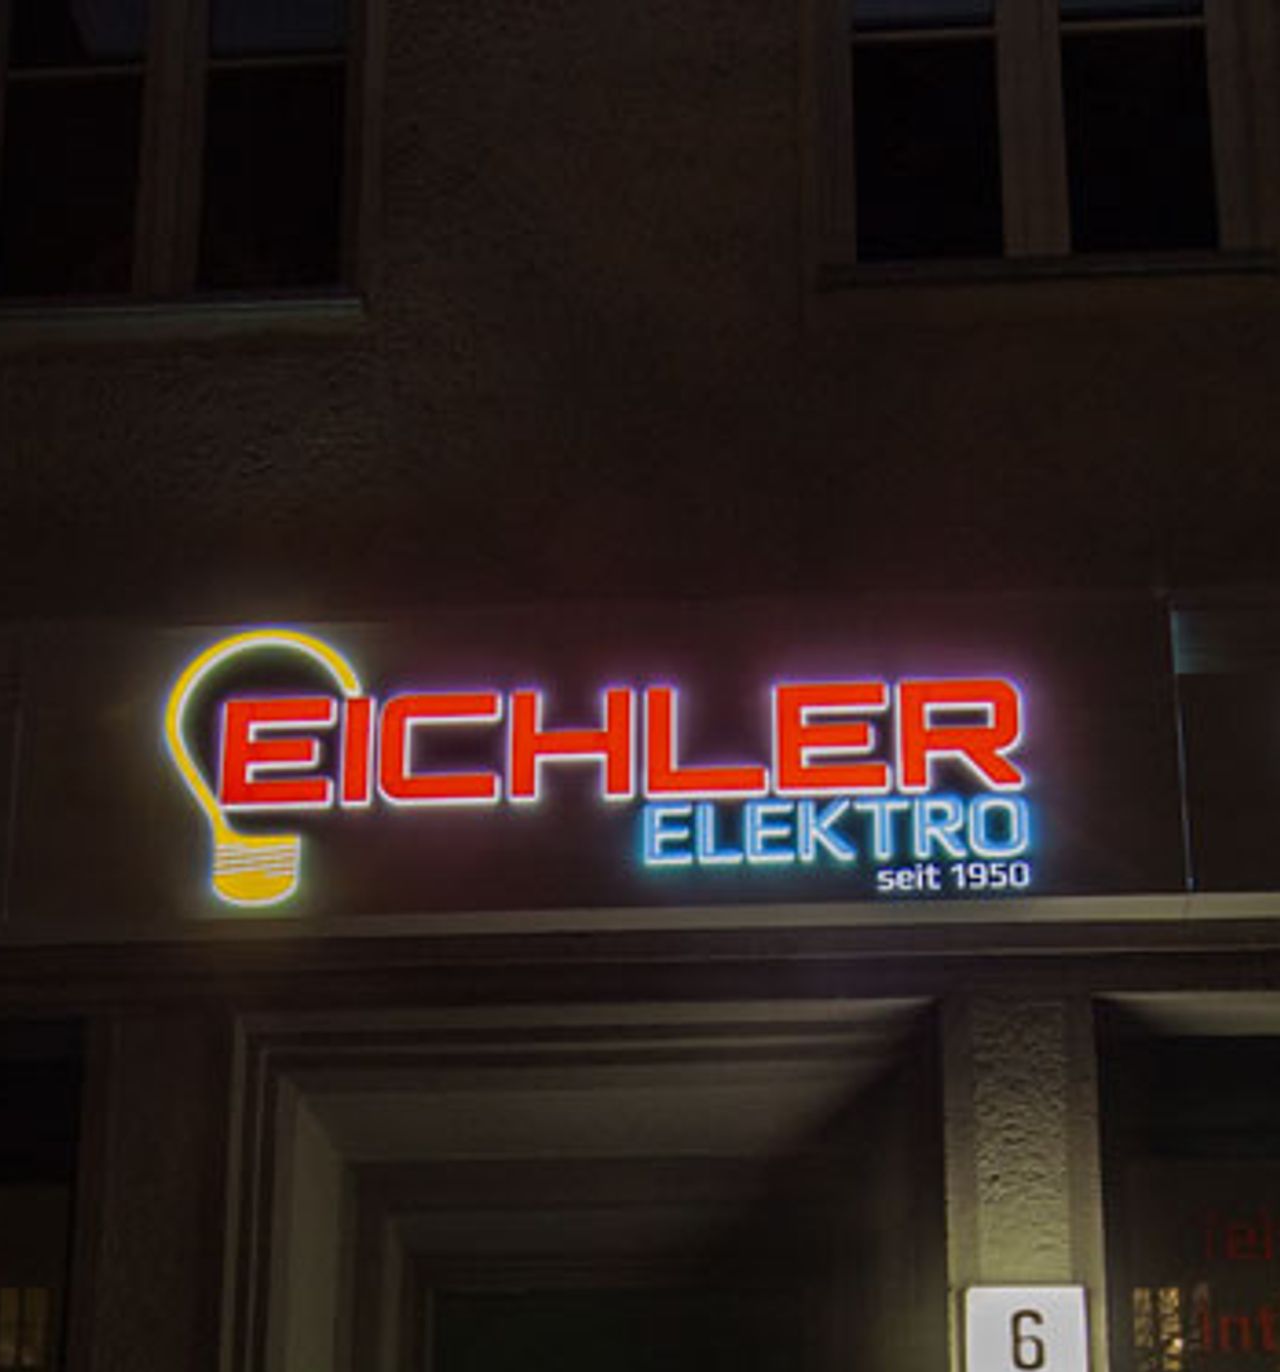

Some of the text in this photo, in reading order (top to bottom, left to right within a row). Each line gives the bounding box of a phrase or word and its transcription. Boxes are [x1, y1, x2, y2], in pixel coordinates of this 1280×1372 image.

[218, 678, 1026, 808] EICHLER
[640, 796, 1032, 866] ELEKTRO
[875, 862, 1032, 892] seit 1950
[1011, 1309, 1044, 1370] 6
